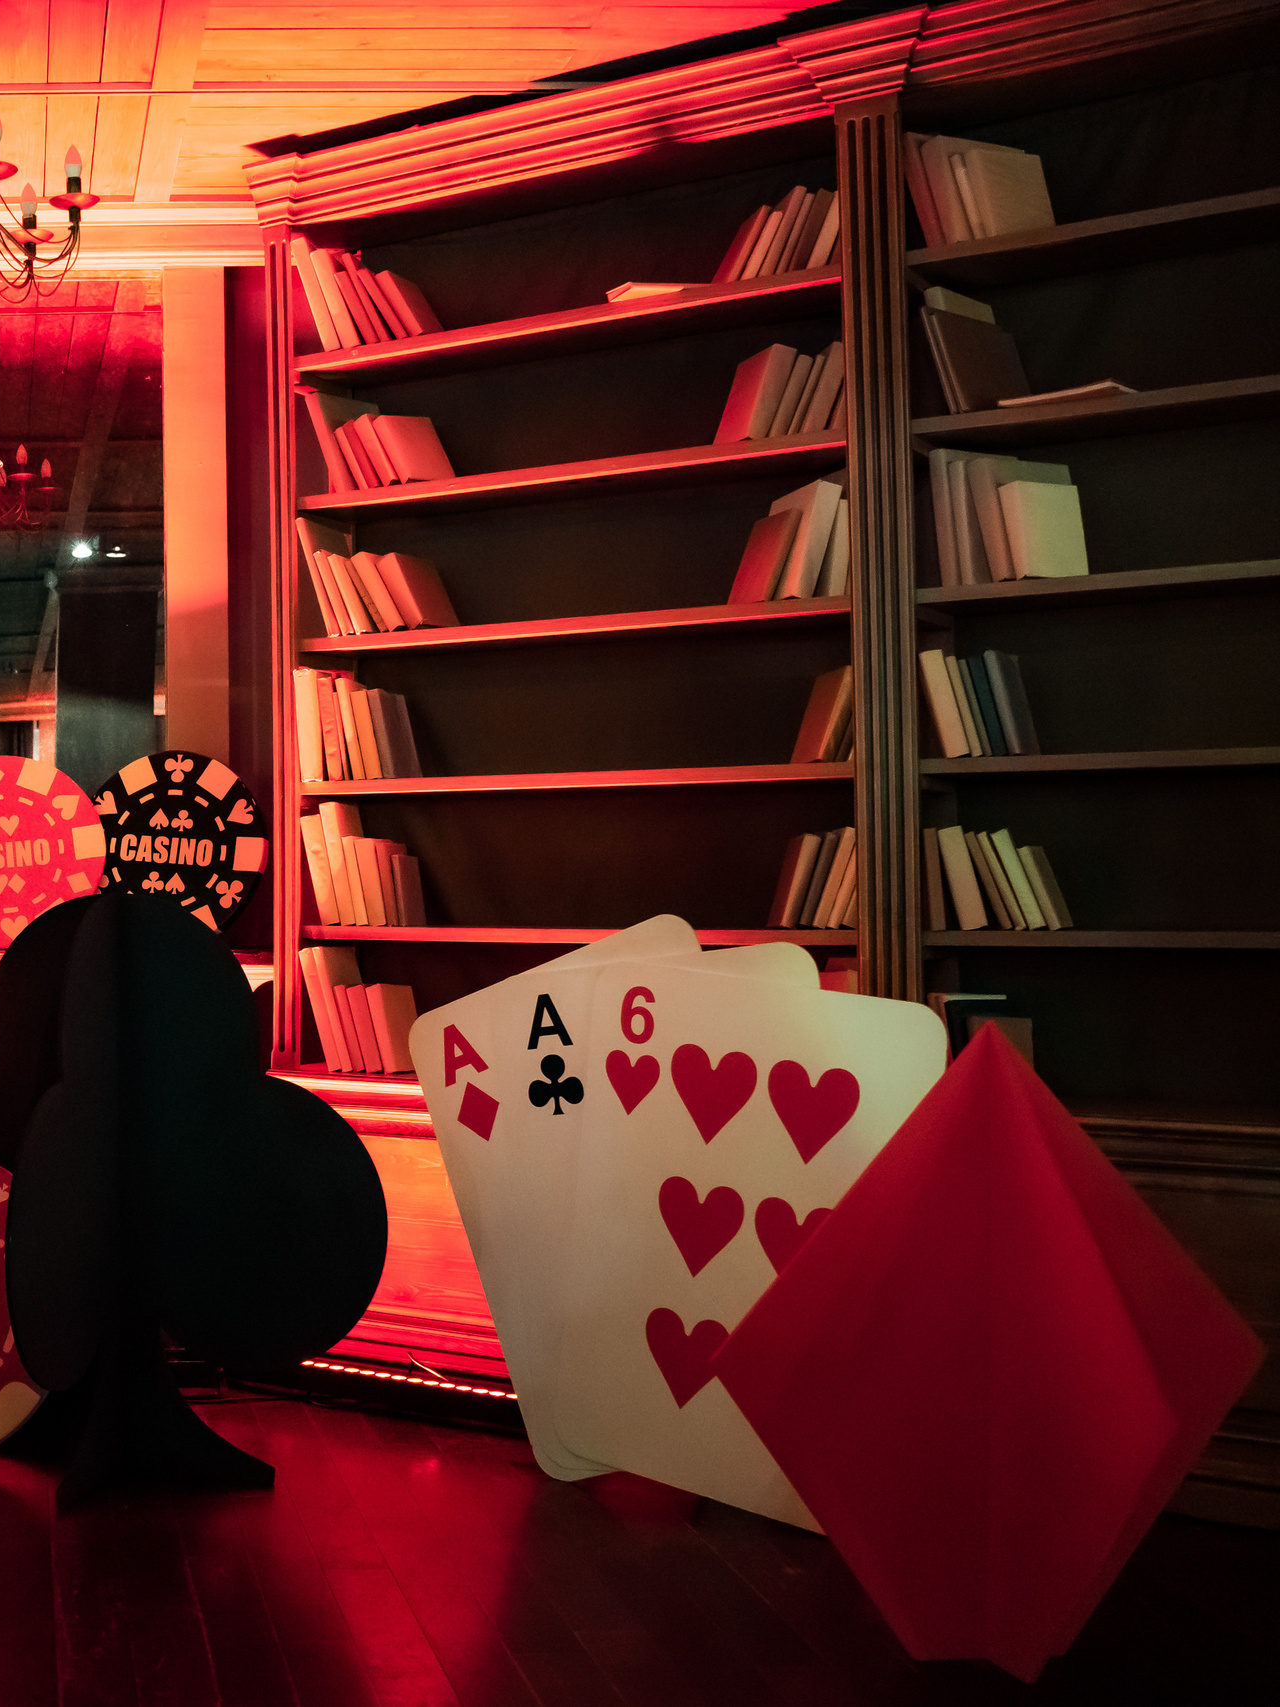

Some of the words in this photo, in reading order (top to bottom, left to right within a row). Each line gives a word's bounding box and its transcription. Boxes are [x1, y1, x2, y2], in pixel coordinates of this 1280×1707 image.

[120, 833, 214, 868] CASINO
[527, 993, 574, 1050] A
[620, 986, 656, 1044] 6
[442, 1023, 489, 1088] A
